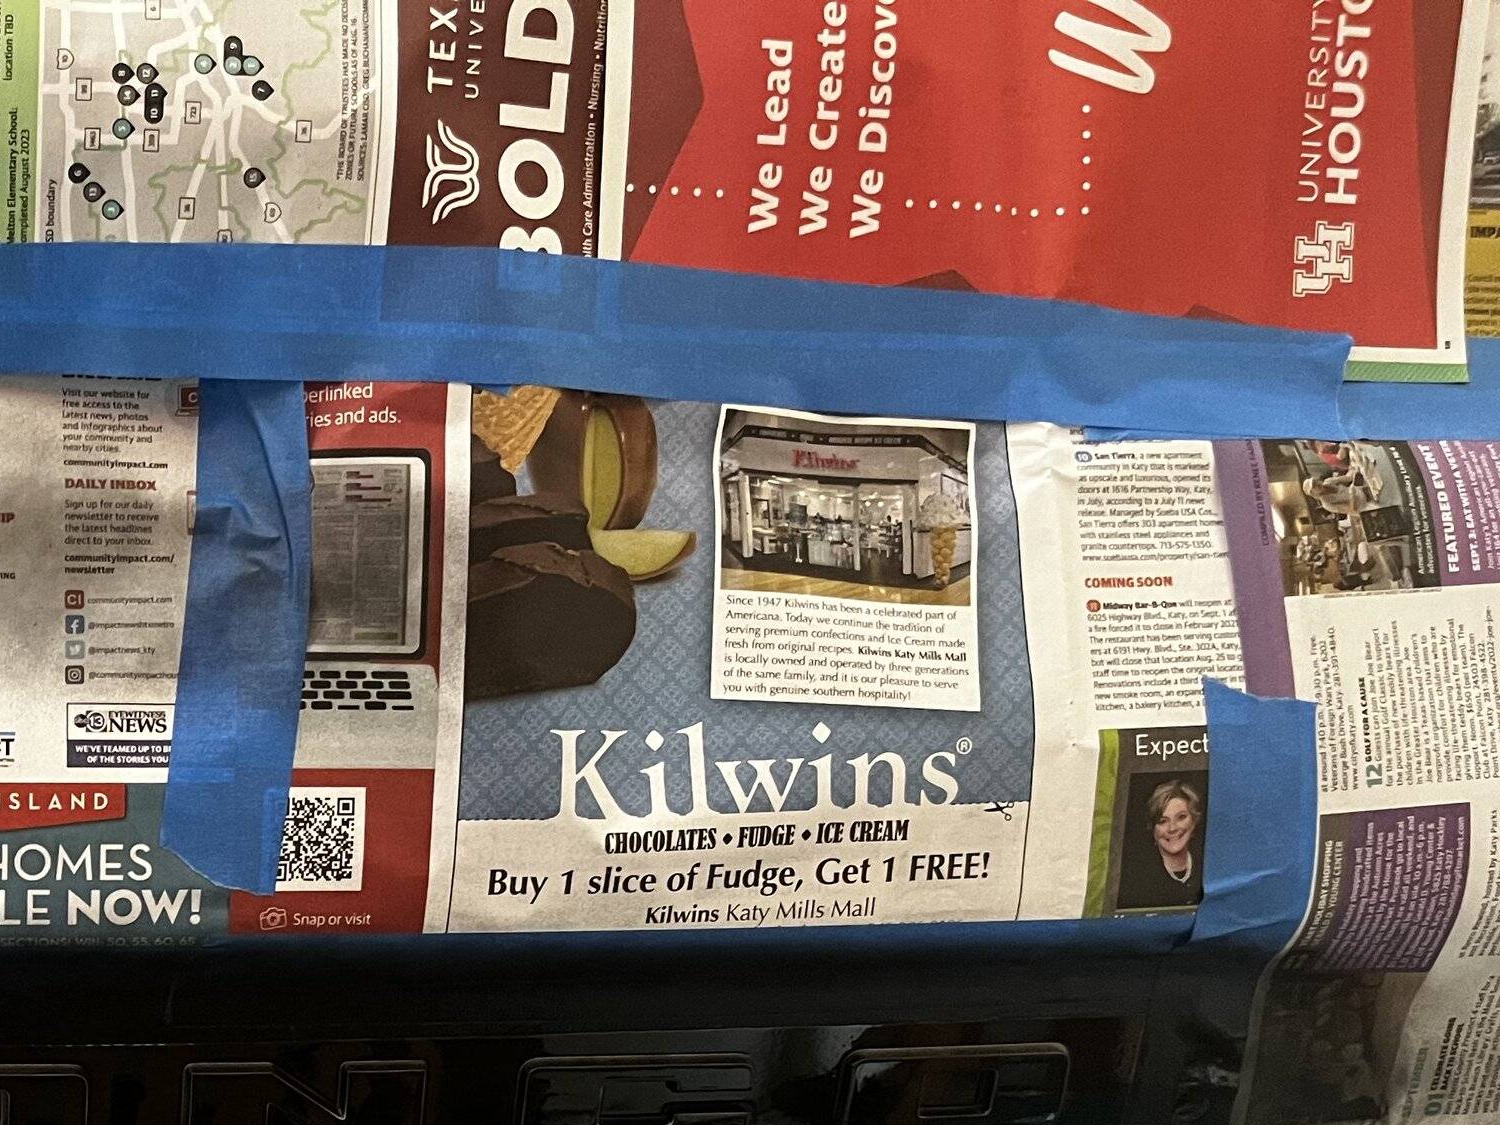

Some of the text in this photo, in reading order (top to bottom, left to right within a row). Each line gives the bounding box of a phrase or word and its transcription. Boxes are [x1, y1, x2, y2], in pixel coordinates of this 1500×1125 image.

[798, 0, 848, 237] We Create
[748, 38, 793, 236] We Lead
[582, 121, 596, 236] Care Administration
[64, 478, 156, 491] DAILY INBOX
[1084, 576, 1174, 589] COMING SOON
[109, 718, 167, 733] NEWS
[1134, 735, 1210, 760] Expect
[549, 721, 958, 821] Kilwins
[604, 819, 910, 855] CHOCOLATES FUDGE ICE CREAM
[487, 852, 990, 904] Buy 1 slice of Fudge, Get 1 FREE!
[66, 889, 201, 927] NOW!
[292, 910, 372, 929] Snap or visit
[645, 897, 876, 925] Kilwins Katy Mills Mall
